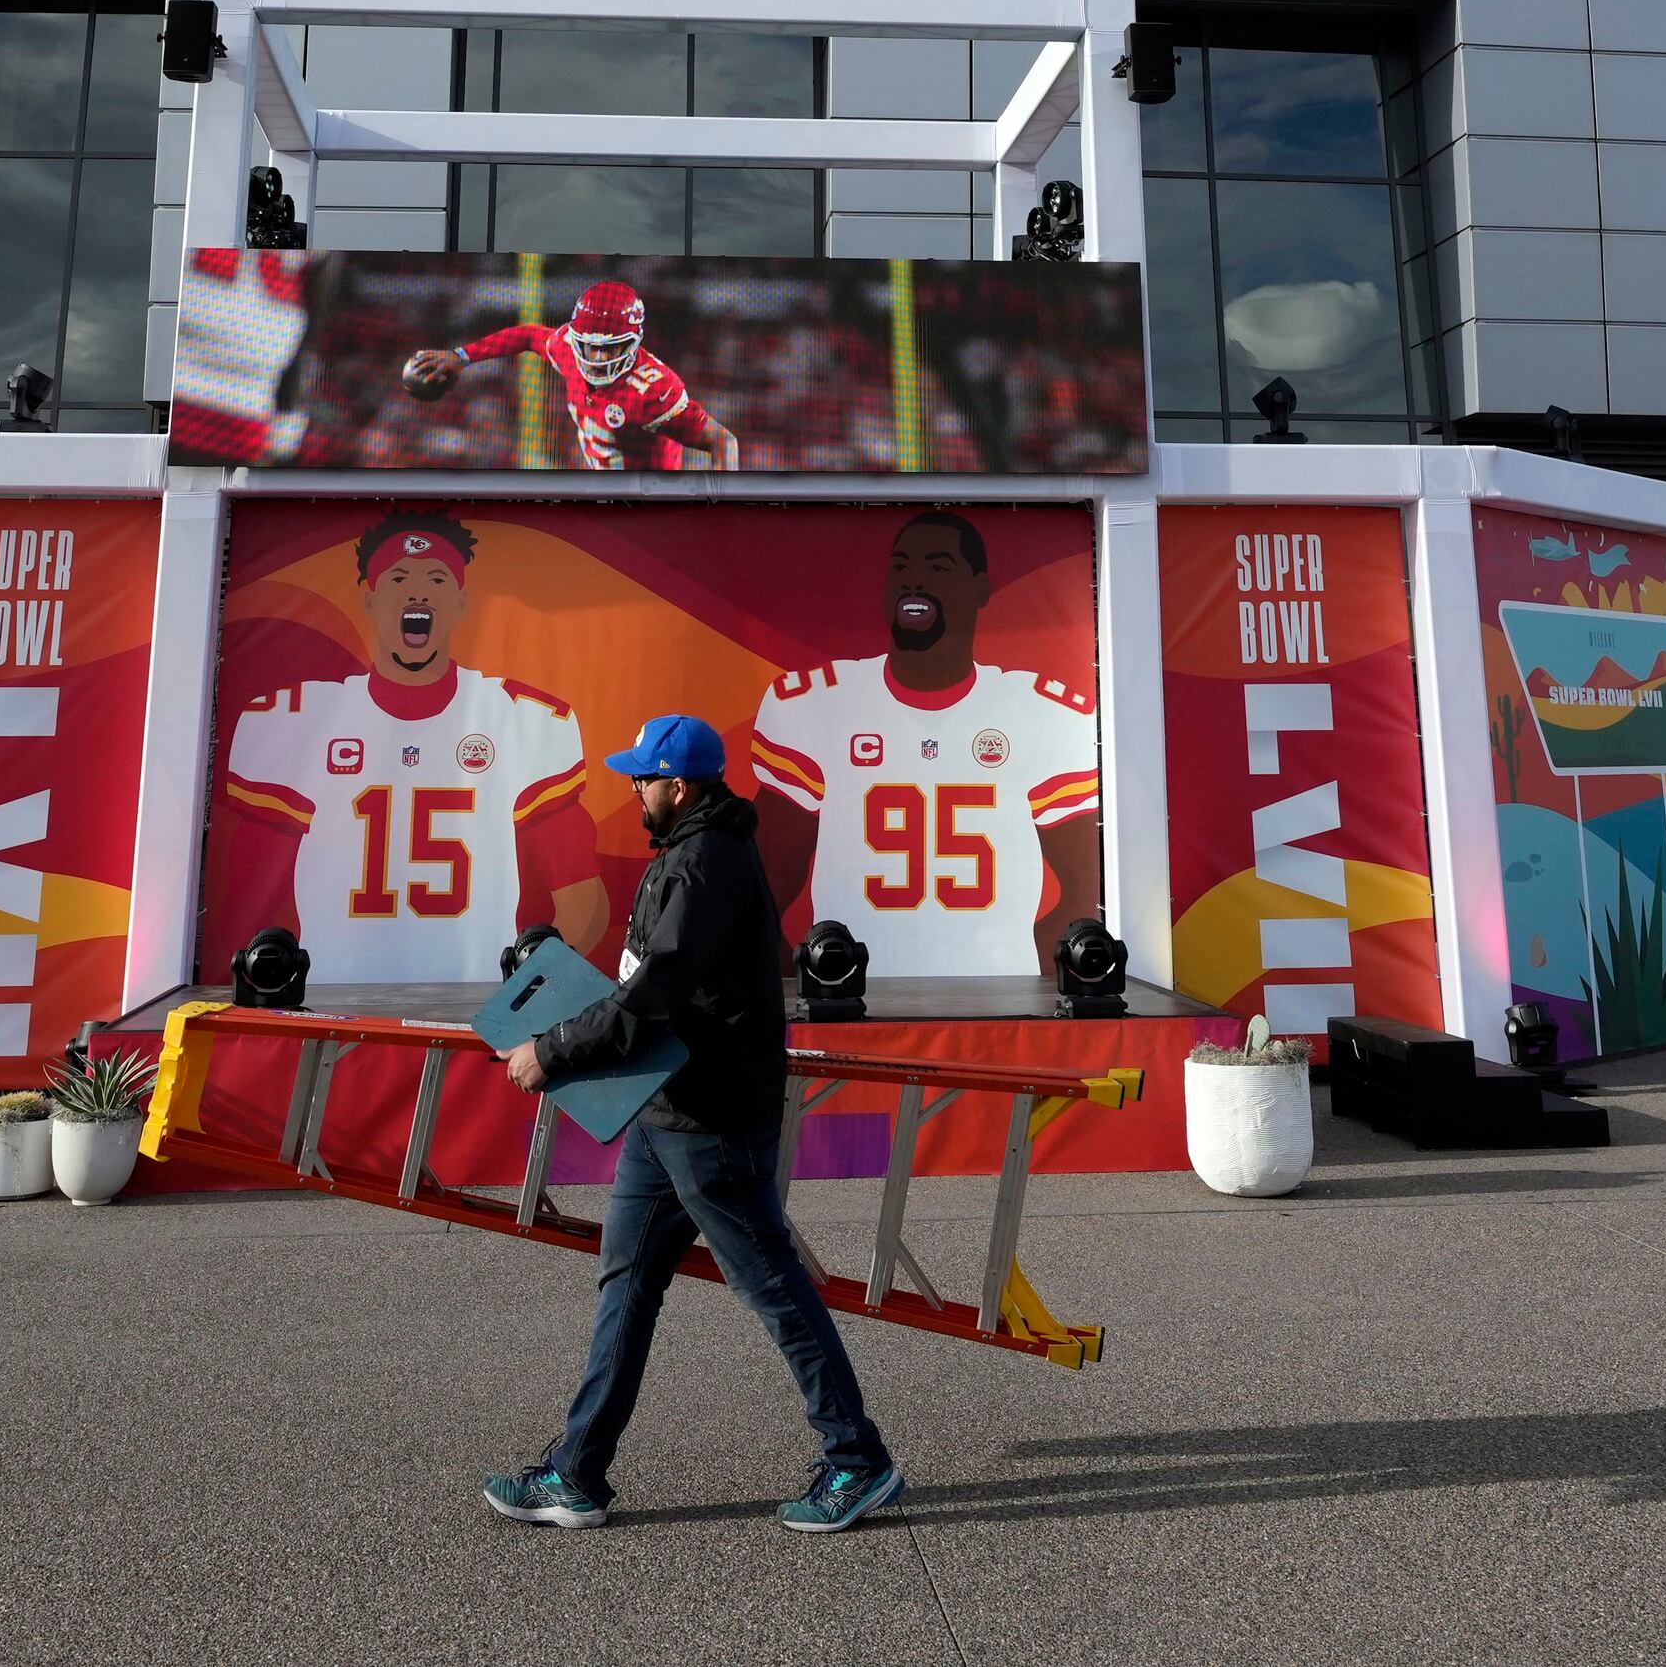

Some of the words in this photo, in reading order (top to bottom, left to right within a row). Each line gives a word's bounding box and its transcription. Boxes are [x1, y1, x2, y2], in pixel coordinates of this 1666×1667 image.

[626, 362, 664, 395] 15
[1235, 533, 1325, 592] SUPER
[1238, 600, 1330, 664] BOWL
[1549, 685, 1596, 706] SUPER
[1598, 688, 1636, 708] BOWL
[1638, 690, 1664, 708] LVII
[331, 741, 360, 766] C
[853, 735, 880, 760] C
[347, 783, 477, 918] 15
[864, 782, 998, 911] 95
[1244, 683, 1356, 1035] LVII
